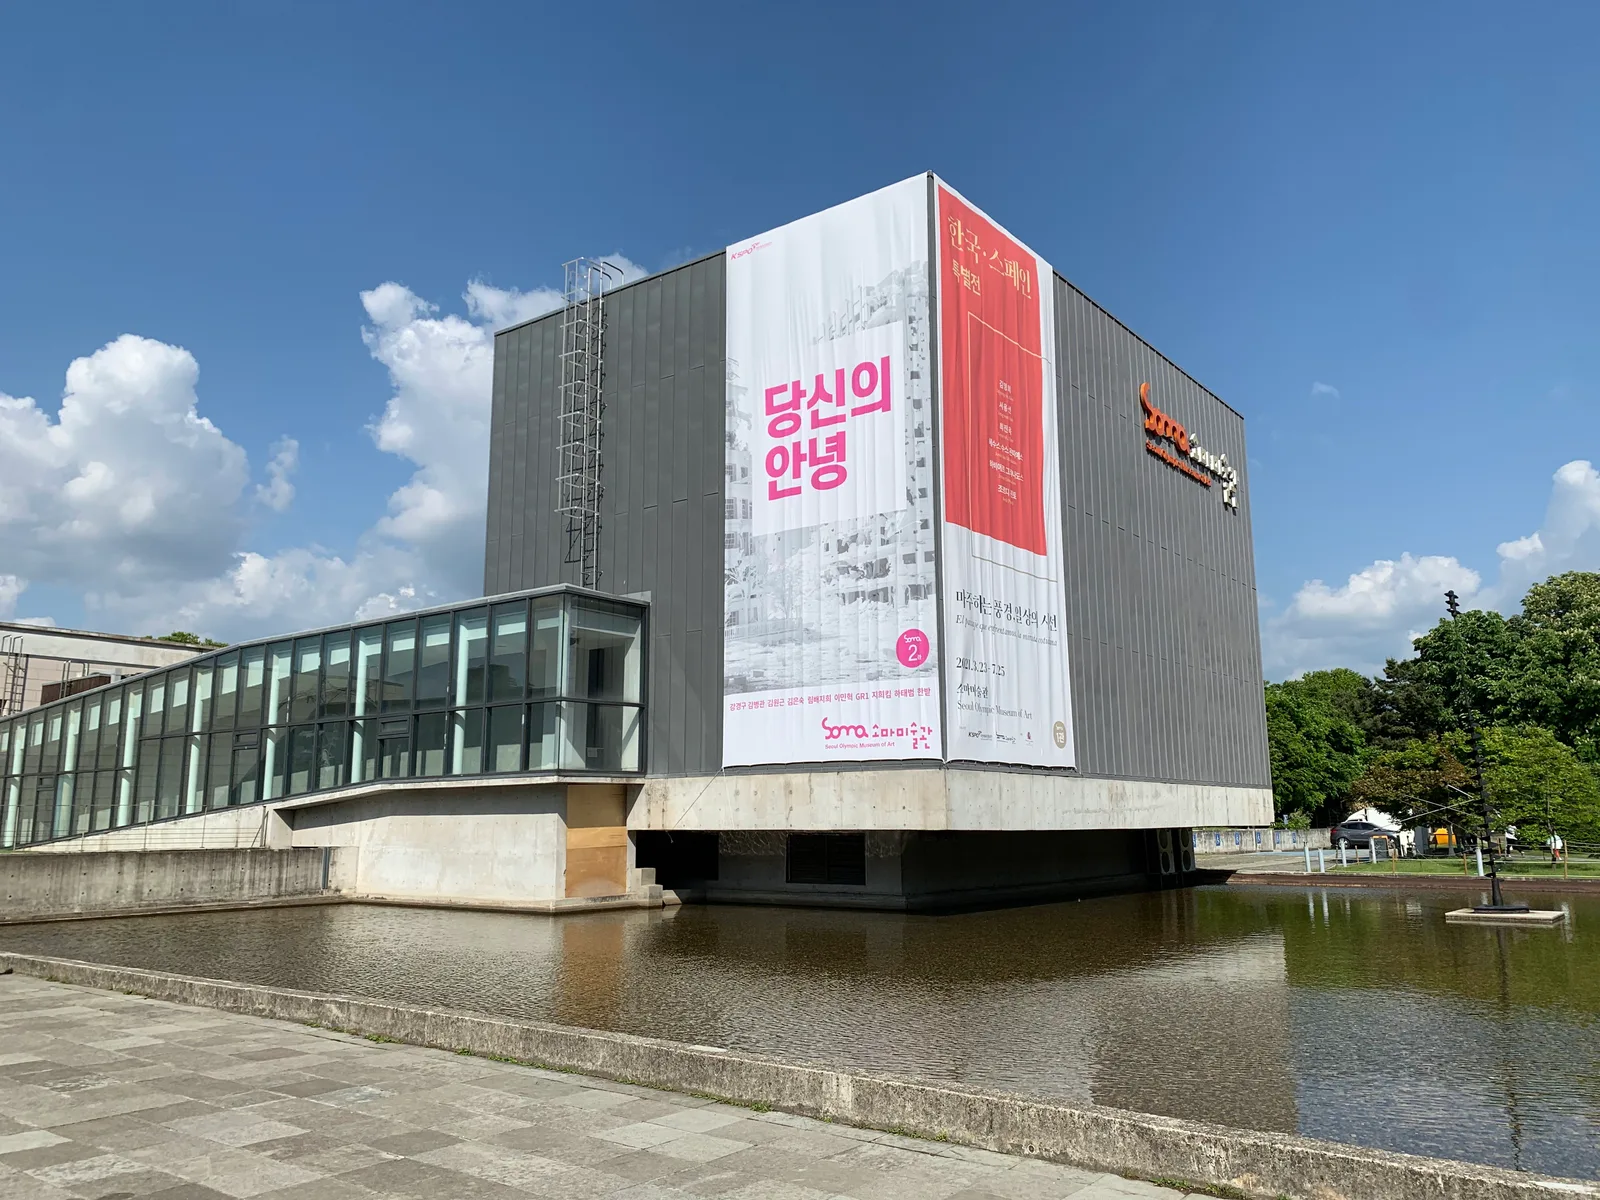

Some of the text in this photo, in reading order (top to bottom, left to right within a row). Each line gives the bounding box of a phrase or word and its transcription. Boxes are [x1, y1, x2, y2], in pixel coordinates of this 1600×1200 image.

[952, 259, 981, 296] 특별전
[765, 355, 891, 439] 당신의
[765, 430, 848, 501] 안녕
[955, 614, 964, 624] El
[956, 589, 992, 615] 마주하는
[1014, 606, 1038, 628] 일상의
[1040, 613, 1057, 631] 시선
[730, 701, 746, 711] 강경구
[767, 698, 785, 707] 김원근
[787, 696, 804, 706] 김은숙
[855, 692, 869, 700] GR1
[872, 690, 892, 699] 지희킴
[894, 688, 915, 697] 하태범
[957, 683, 988, 699] 소마미술관
[957, 700, 1033, 719] Seoul Olympic Museum of Art
[872, 722, 933, 749] 소마미술관
